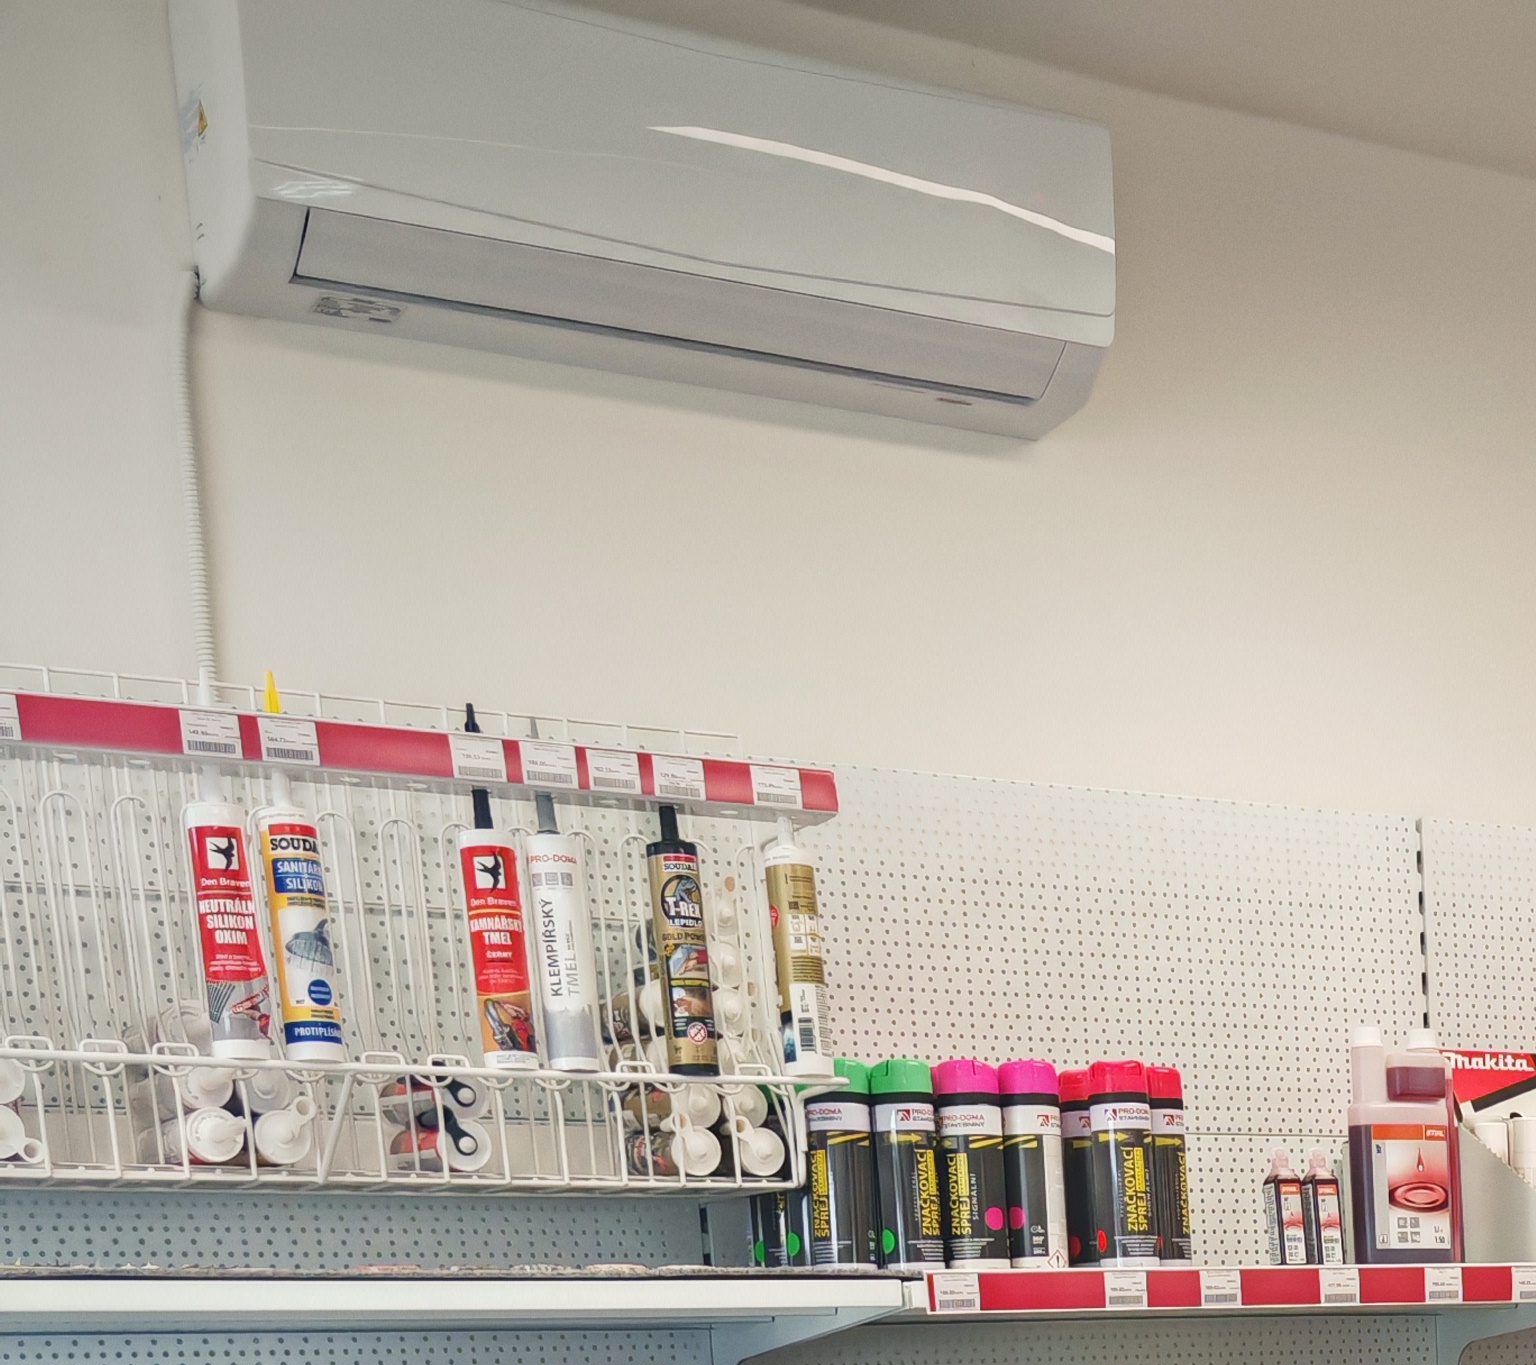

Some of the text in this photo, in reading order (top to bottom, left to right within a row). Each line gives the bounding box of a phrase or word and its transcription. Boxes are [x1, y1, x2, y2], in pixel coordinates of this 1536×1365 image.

[270, 837, 319, 852] SOUDA
[206, 914, 254, 930] SILIKON
[215, 930, 248, 945] OXIM
[482, 932, 513, 945] TMEL
[563, 953, 580, 997] TMEL
[1120, 1146, 1139, 1232] ZNAČKOVACÍ
[1136, 1190, 1148, 1231] SPREJ
